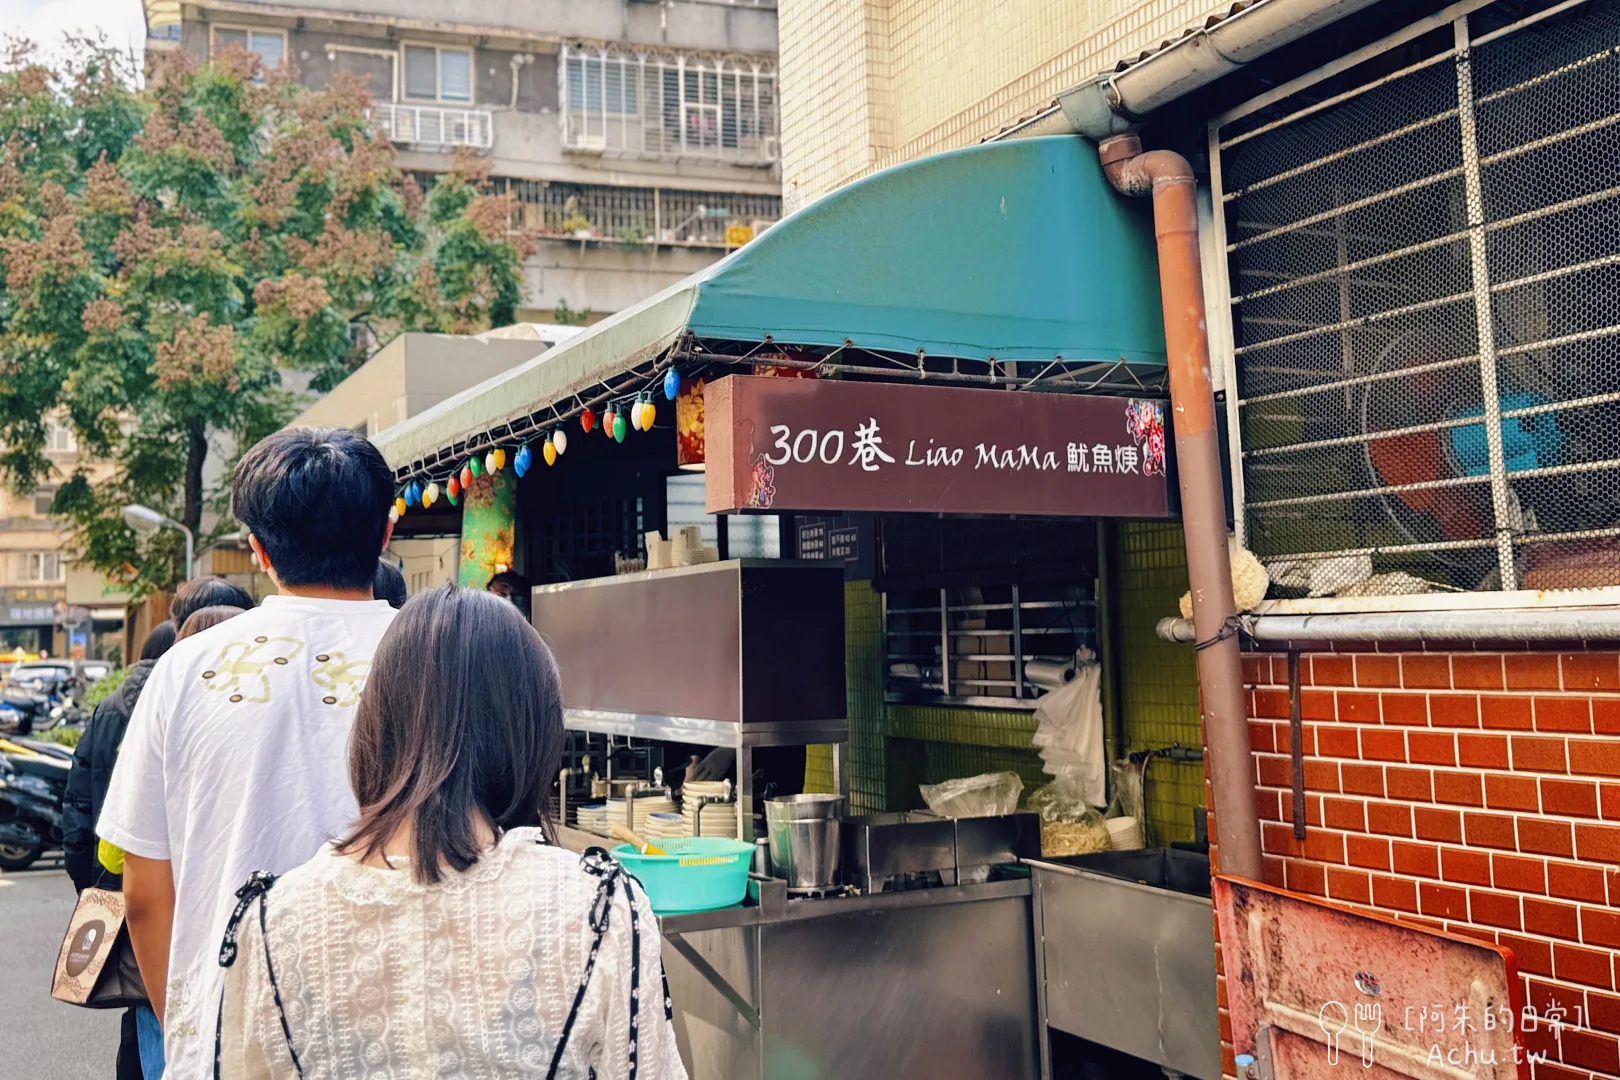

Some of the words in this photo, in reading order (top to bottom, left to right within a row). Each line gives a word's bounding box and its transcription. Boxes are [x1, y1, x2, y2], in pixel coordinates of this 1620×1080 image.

[765, 417, 896, 471] 300巷
[905, 437, 964, 468] Liao
[974, 443, 1060, 471] MaMa
